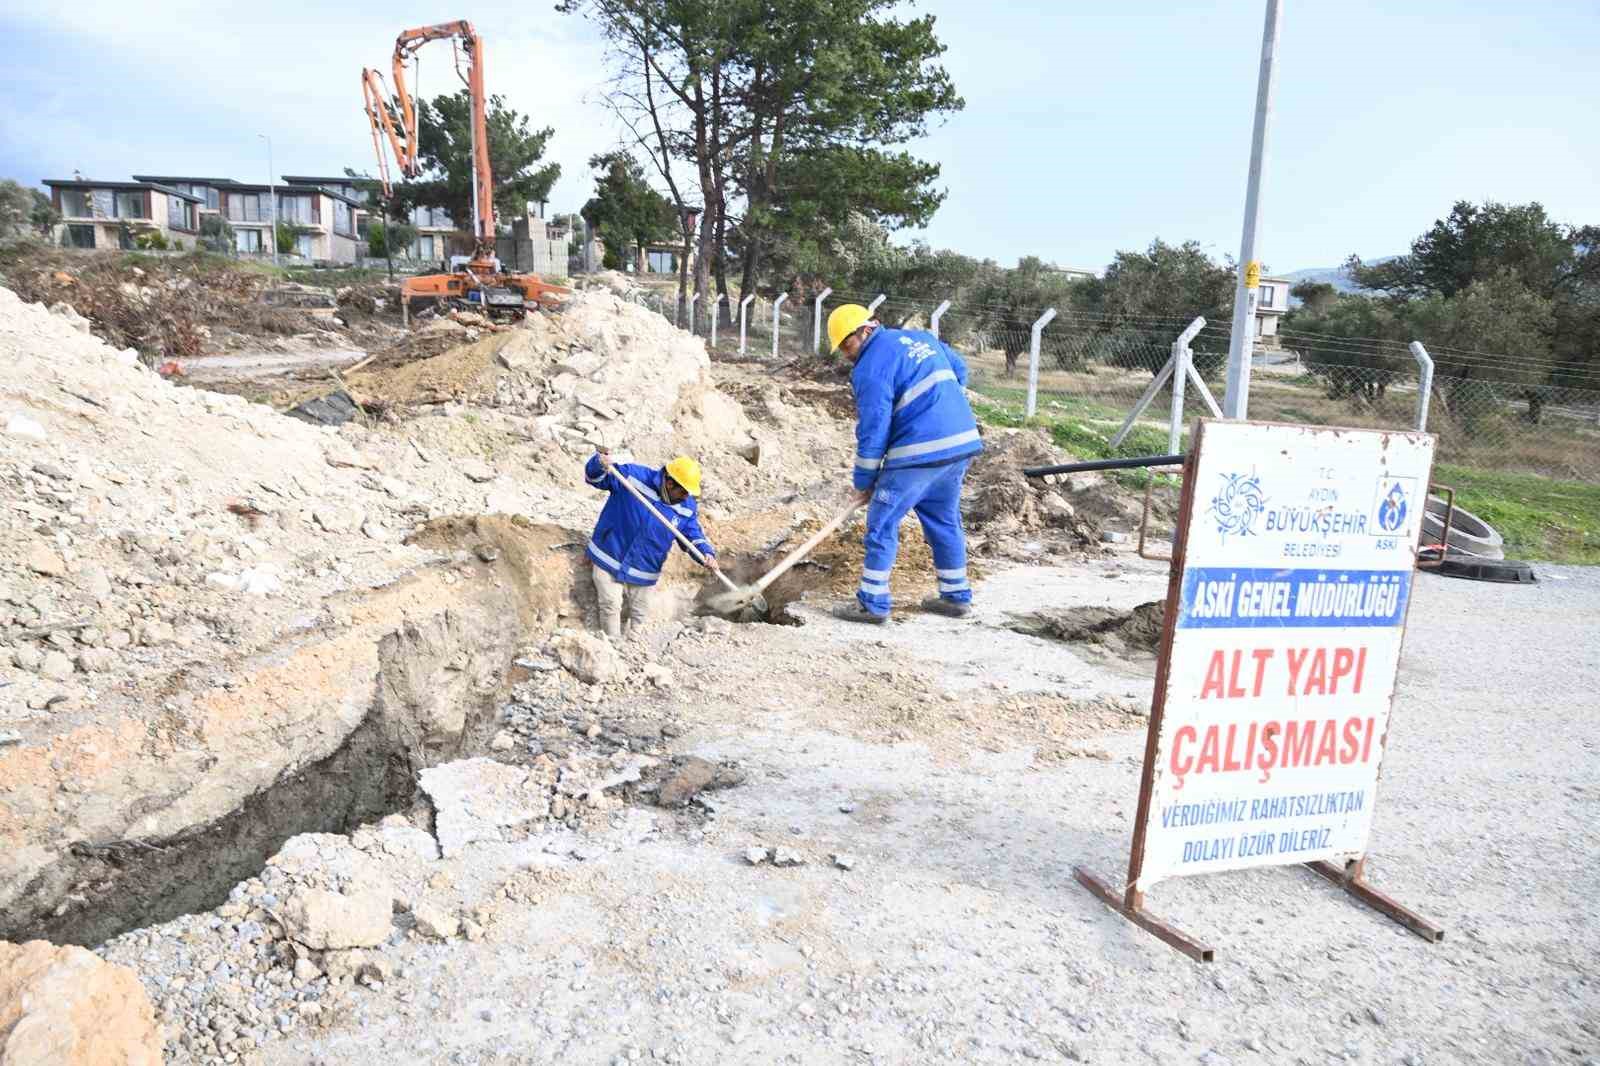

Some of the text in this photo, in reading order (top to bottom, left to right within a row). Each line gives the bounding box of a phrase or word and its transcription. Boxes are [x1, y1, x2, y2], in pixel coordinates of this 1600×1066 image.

[1266, 506, 1367, 538] BÜYÜKŞEHİR
[1192, 574, 1399, 618] ASKİ GENEL MÜDÜRLÜĞÜ
[1200, 647, 1367, 699] ALT YAPI
[1170, 717, 1375, 789] ÇALIŞMASI
[1162, 790, 1364, 828] VERDİĞİMİZ RAHATSIZLIKTAN
[1182, 838, 1235, 863] DOLAYI
[1238, 830, 1275, 857] ÖZÜR
